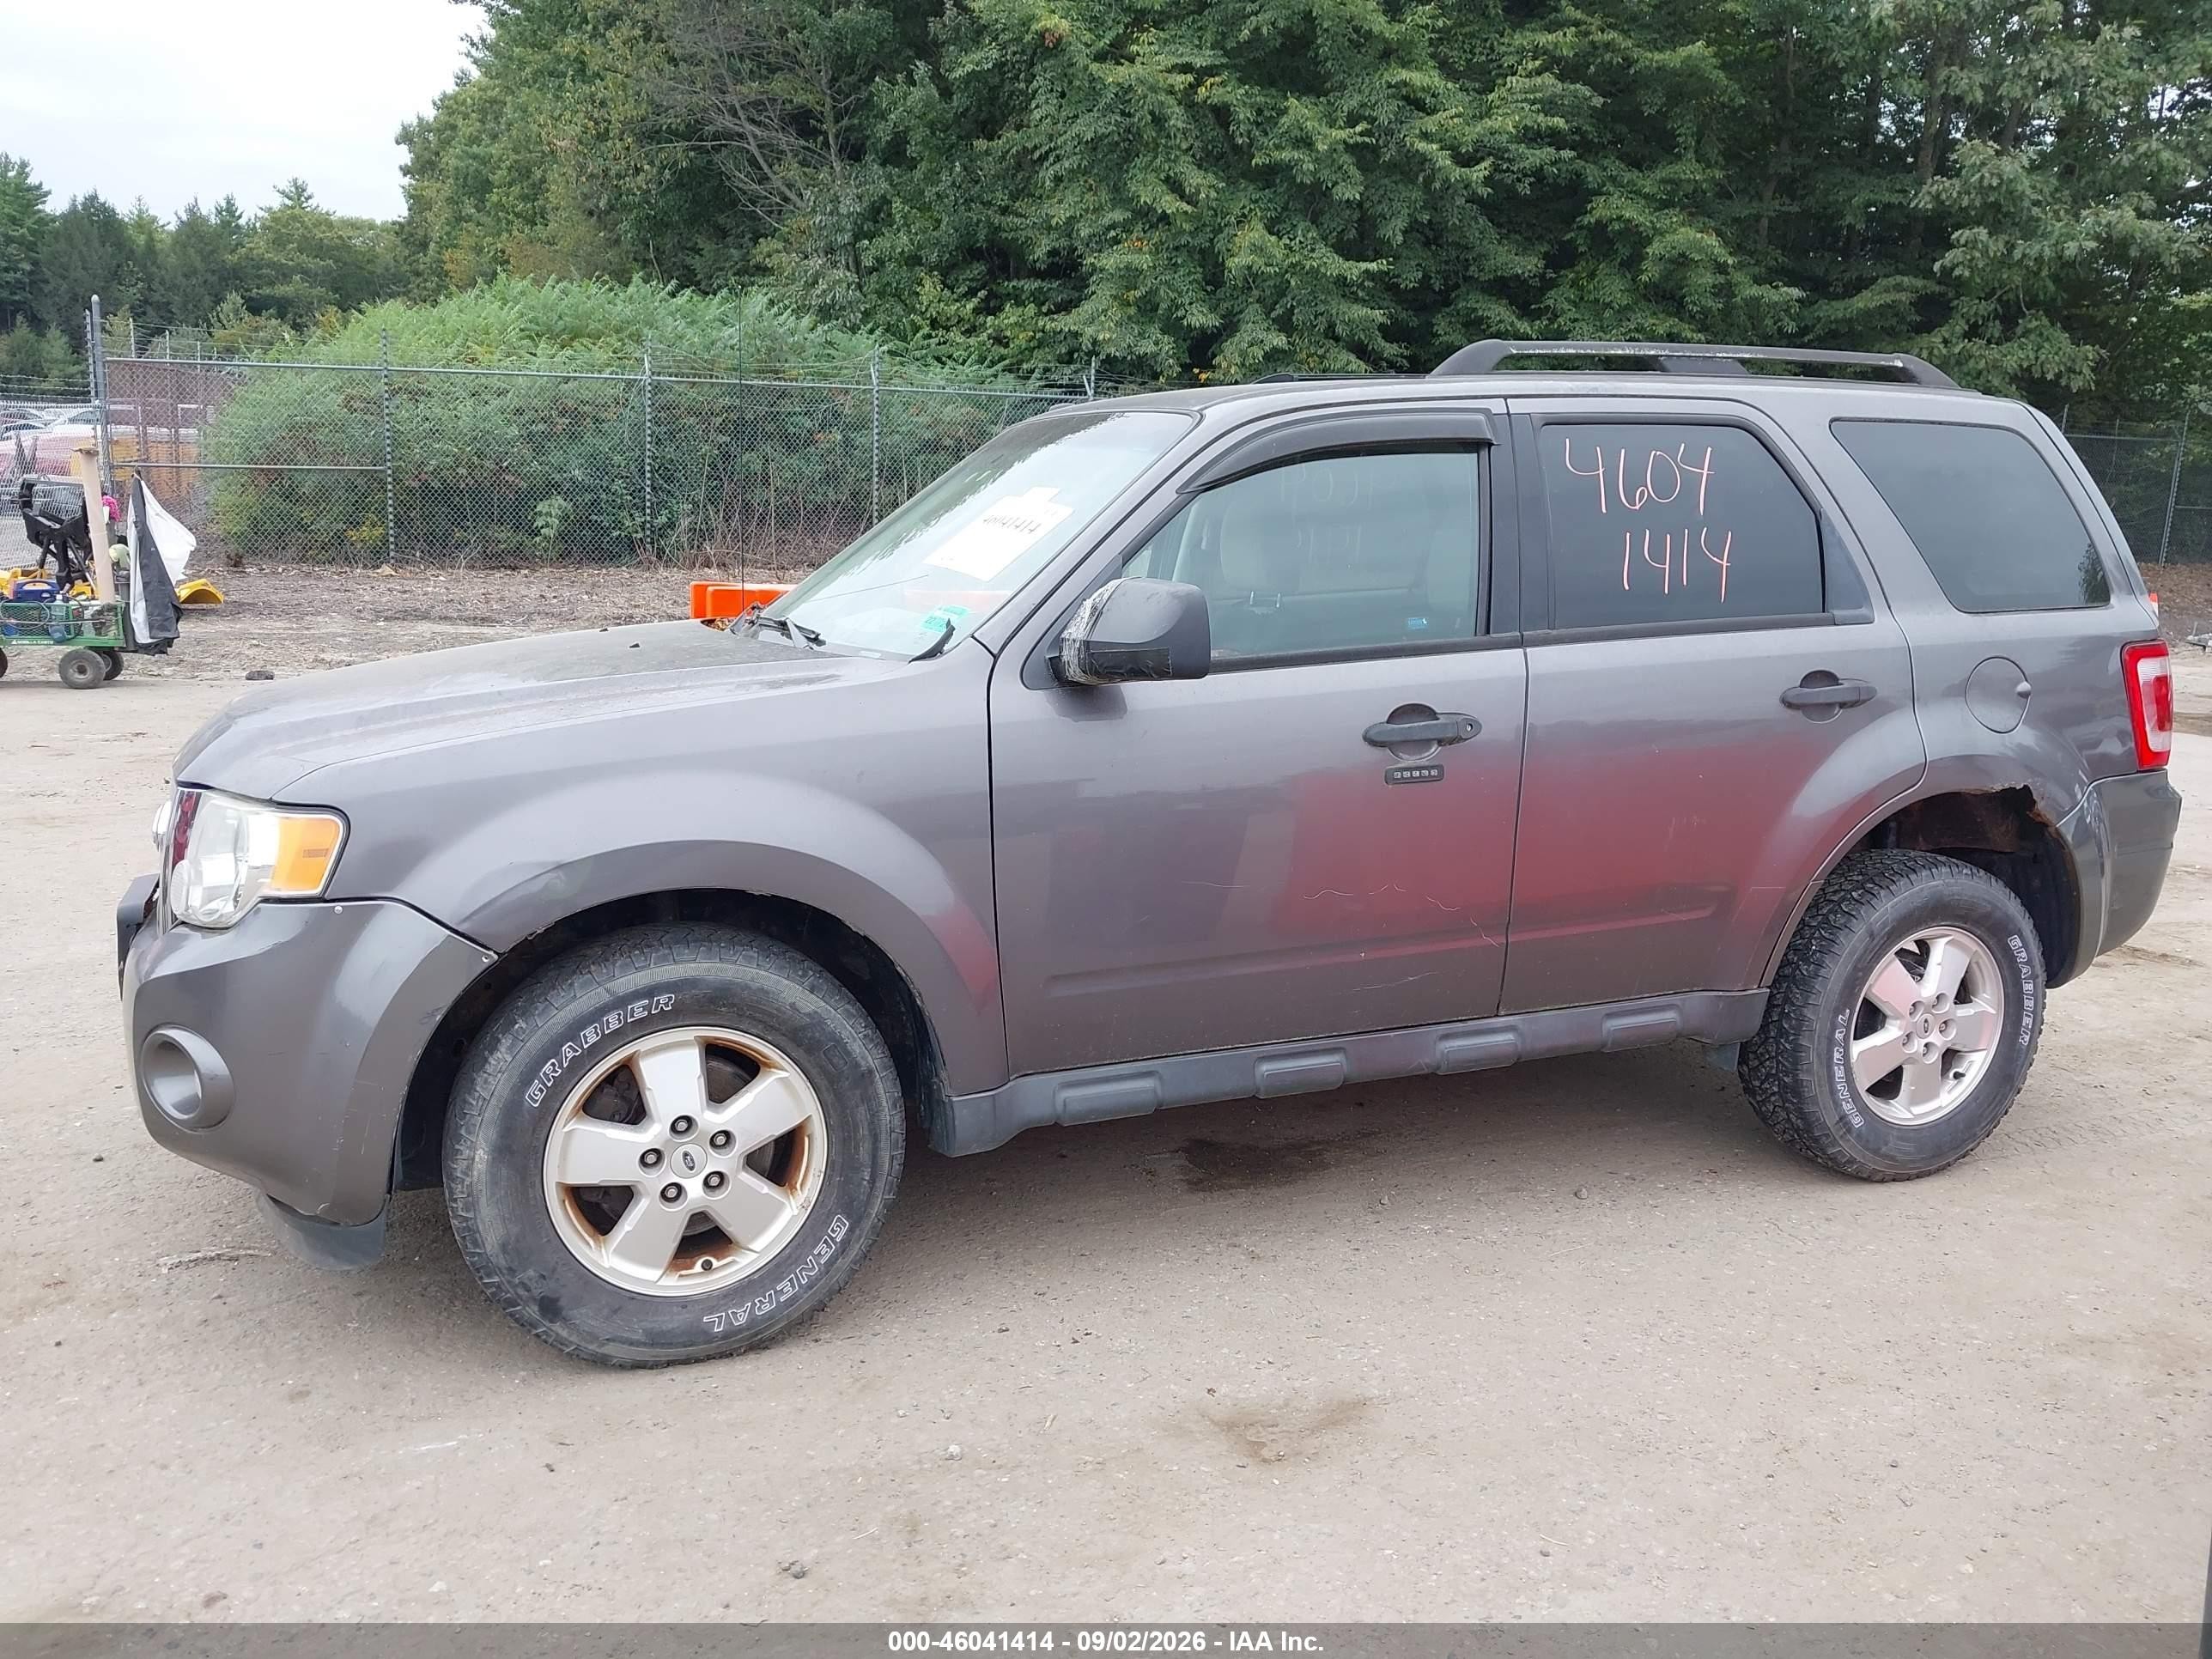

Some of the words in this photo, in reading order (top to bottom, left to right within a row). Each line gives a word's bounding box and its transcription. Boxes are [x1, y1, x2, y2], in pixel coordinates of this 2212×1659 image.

[1565, 438, 1715, 515] 4604
[1623, 527, 1731, 603] 1414
[2008, 934, 2034, 1046] GRABBER
[526, 994, 675, 1107] GRABBER
[1834, 1009, 1864, 1128] GENERAL
[703, 1215, 849, 1332] GENERAL
